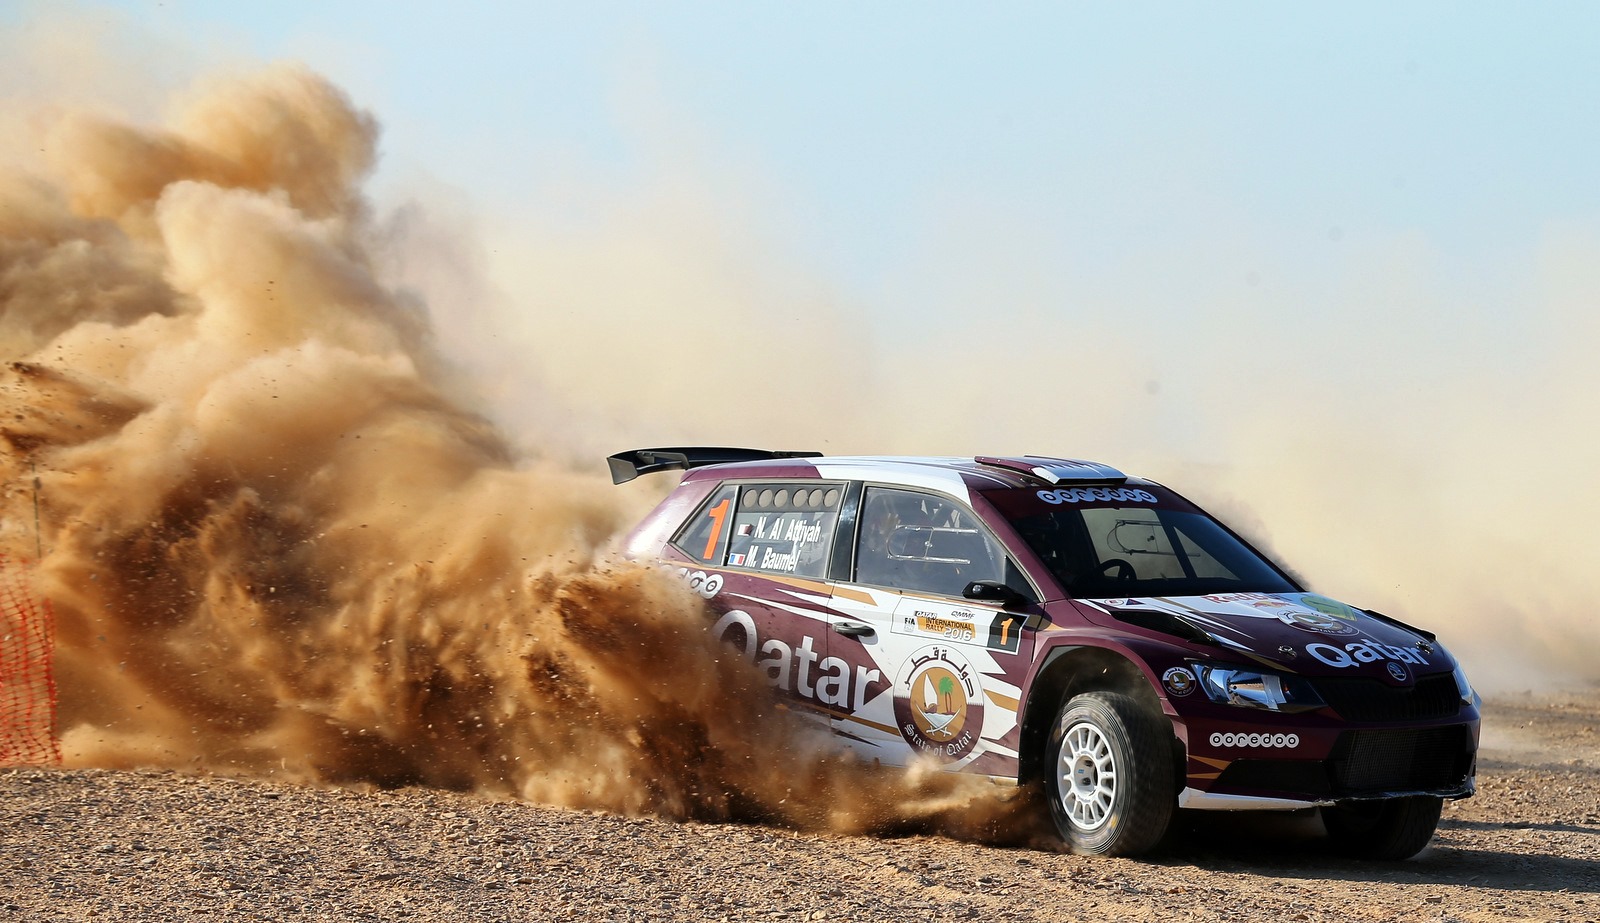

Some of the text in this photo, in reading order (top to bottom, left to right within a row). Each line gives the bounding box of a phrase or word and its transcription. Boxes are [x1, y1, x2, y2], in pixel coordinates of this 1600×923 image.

[703, 499, 730, 560] 1
[754, 517, 821, 547] N. Al Attiyah
[744, 545, 801, 571] M. Baumel
[925, 618, 971, 631] INTERNATIONAL
[925, 624, 943, 632] RALLY
[944, 627, 972, 641] 2016
[1000, 617, 1014, 646] 1
[1305, 638, 1430, 668] Qatar
[947, 731, 972, 755] Qatar
[1209, 732, 1300, 748] ooredoo
